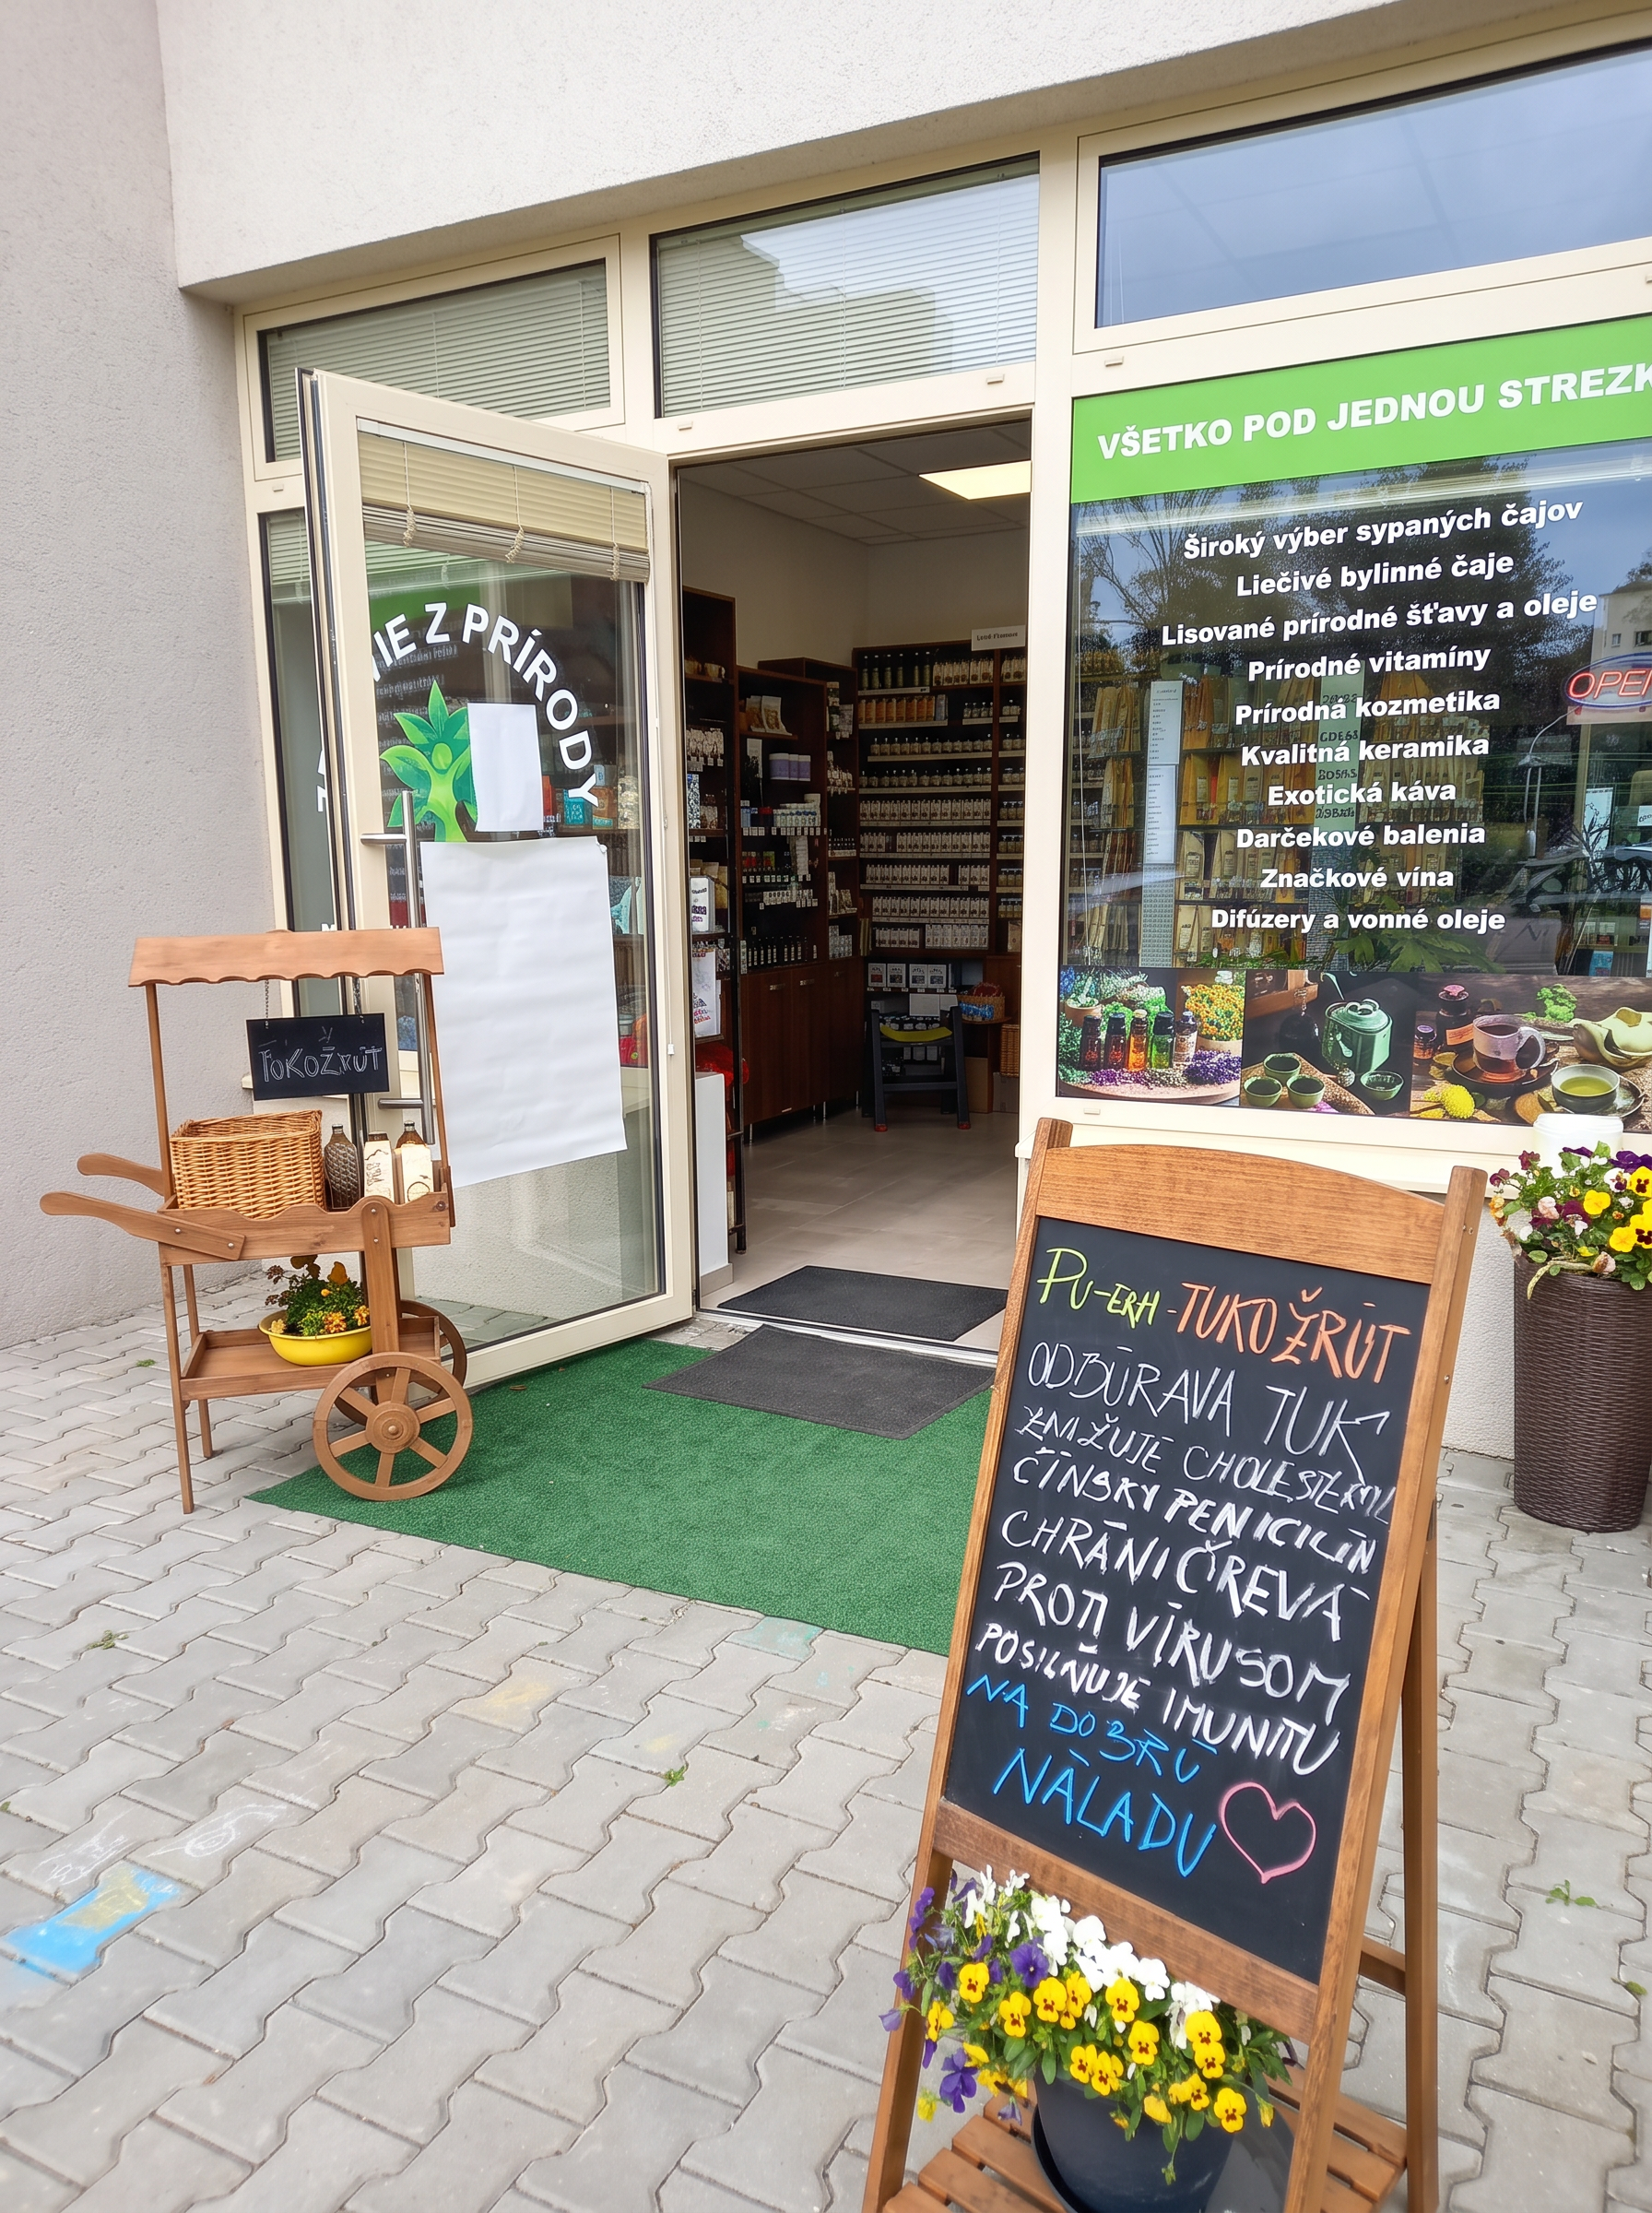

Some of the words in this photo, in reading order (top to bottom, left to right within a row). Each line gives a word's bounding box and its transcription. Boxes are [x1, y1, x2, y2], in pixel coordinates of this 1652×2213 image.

[1097, 419, 1233, 460] VŠETKO
[1244, 408, 1316, 442] POD
[1327, 383, 1485, 432] JEDNOU
[1184, 531, 1266, 560] Široký
[1272, 526, 1349, 555] výber
[1354, 507, 1492, 547] sypaných
[1500, 500, 1584, 529] čajov
[1236, 567, 1331, 597] Liečivé
[1340, 555, 1442, 591] bylinné
[1451, 551, 1514, 580] čaje
[1162, 616, 1275, 645] Lisované
[1283, 609, 1398, 642] prírodné
[1406, 601, 1487, 626] šťavy
[1496, 601, 1514, 619] a
[1524, 590, 1598, 620] oleje
[1248, 653, 1361, 681] Prírodné
[1368, 645, 1492, 673] vitamíny
[424, 601, 451, 645] Z
[462, 602, 599, 808] PRÍRODY
[1235, 697, 1347, 726] Prírodná
[1355, 690, 1500, 718] kozmetika
[1241, 740, 1351, 766] Kvalitná
[1359, 735, 1489, 761] keramika
[1268, 781, 1383, 806] Exotická
[1391, 779, 1457, 802] káva
[1236, 825, 1375, 848] Darčekové
[1383, 822, 1485, 846] balenia
[1259, 865, 1387, 888] Značkové
[1396, 866, 1455, 888] vína
[1211, 908, 1316, 934] Difúzery
[1323, 914, 1339, 929] a
[1347, 908, 1429, 929] vonné
[1436, 908, 1505, 935] oleje
[1265, 1385, 1391, 1485] TUK
[966, 1674, 1029, 1728] NA
[1162, 1686, 1341, 1776] IMUNITU
[993, 1747, 1217, 1877] NÁLADU
